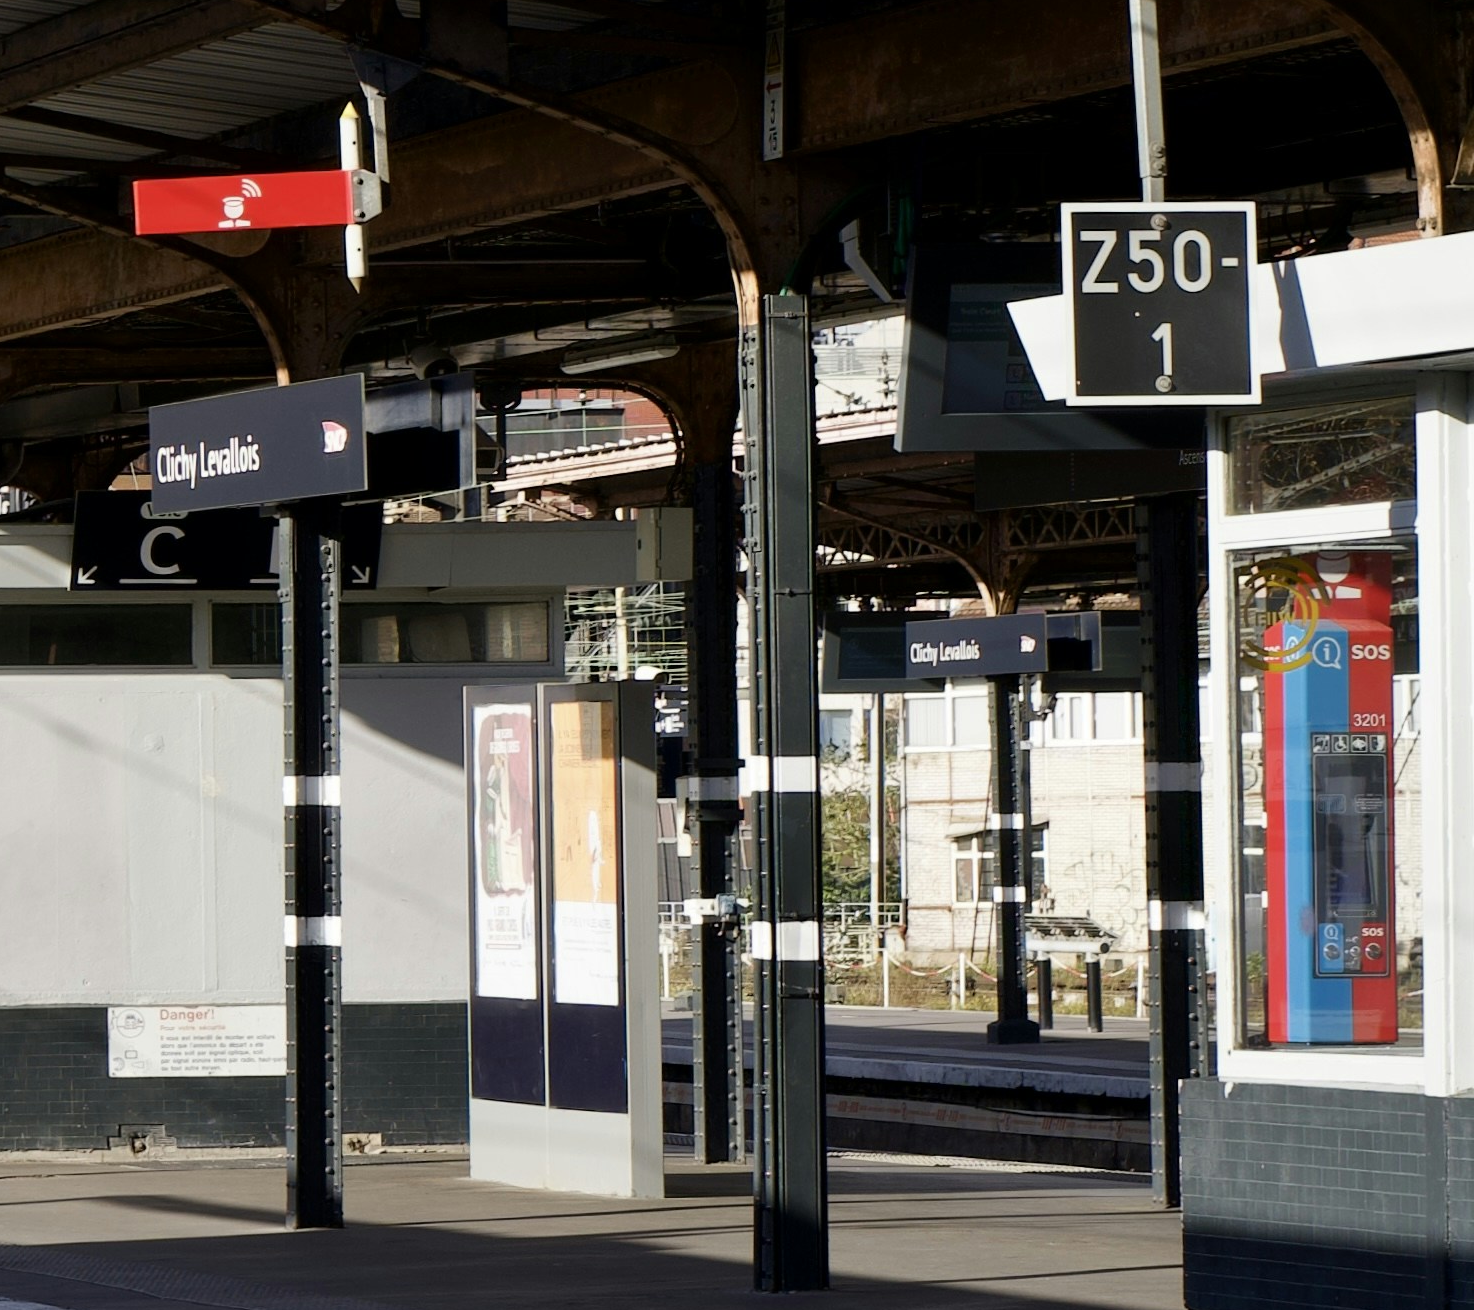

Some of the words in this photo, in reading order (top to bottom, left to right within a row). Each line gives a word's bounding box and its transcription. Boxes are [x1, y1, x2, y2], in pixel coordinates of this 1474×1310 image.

[1080, 229, 1239, 294] Z50-
[1151, 322, 1173, 376] 1
[156, 443, 198, 489] Clichy
[200, 434, 260, 478] Levallois
[139, 525, 186, 574] C
[910, 641, 938, 667] Clichy
[939, 639, 980, 661] Levallois
[1351, 644, 1391, 660] SOS
[1353, 713, 1386, 727] 3201
[1361, 927, 1384, 937] SOS
